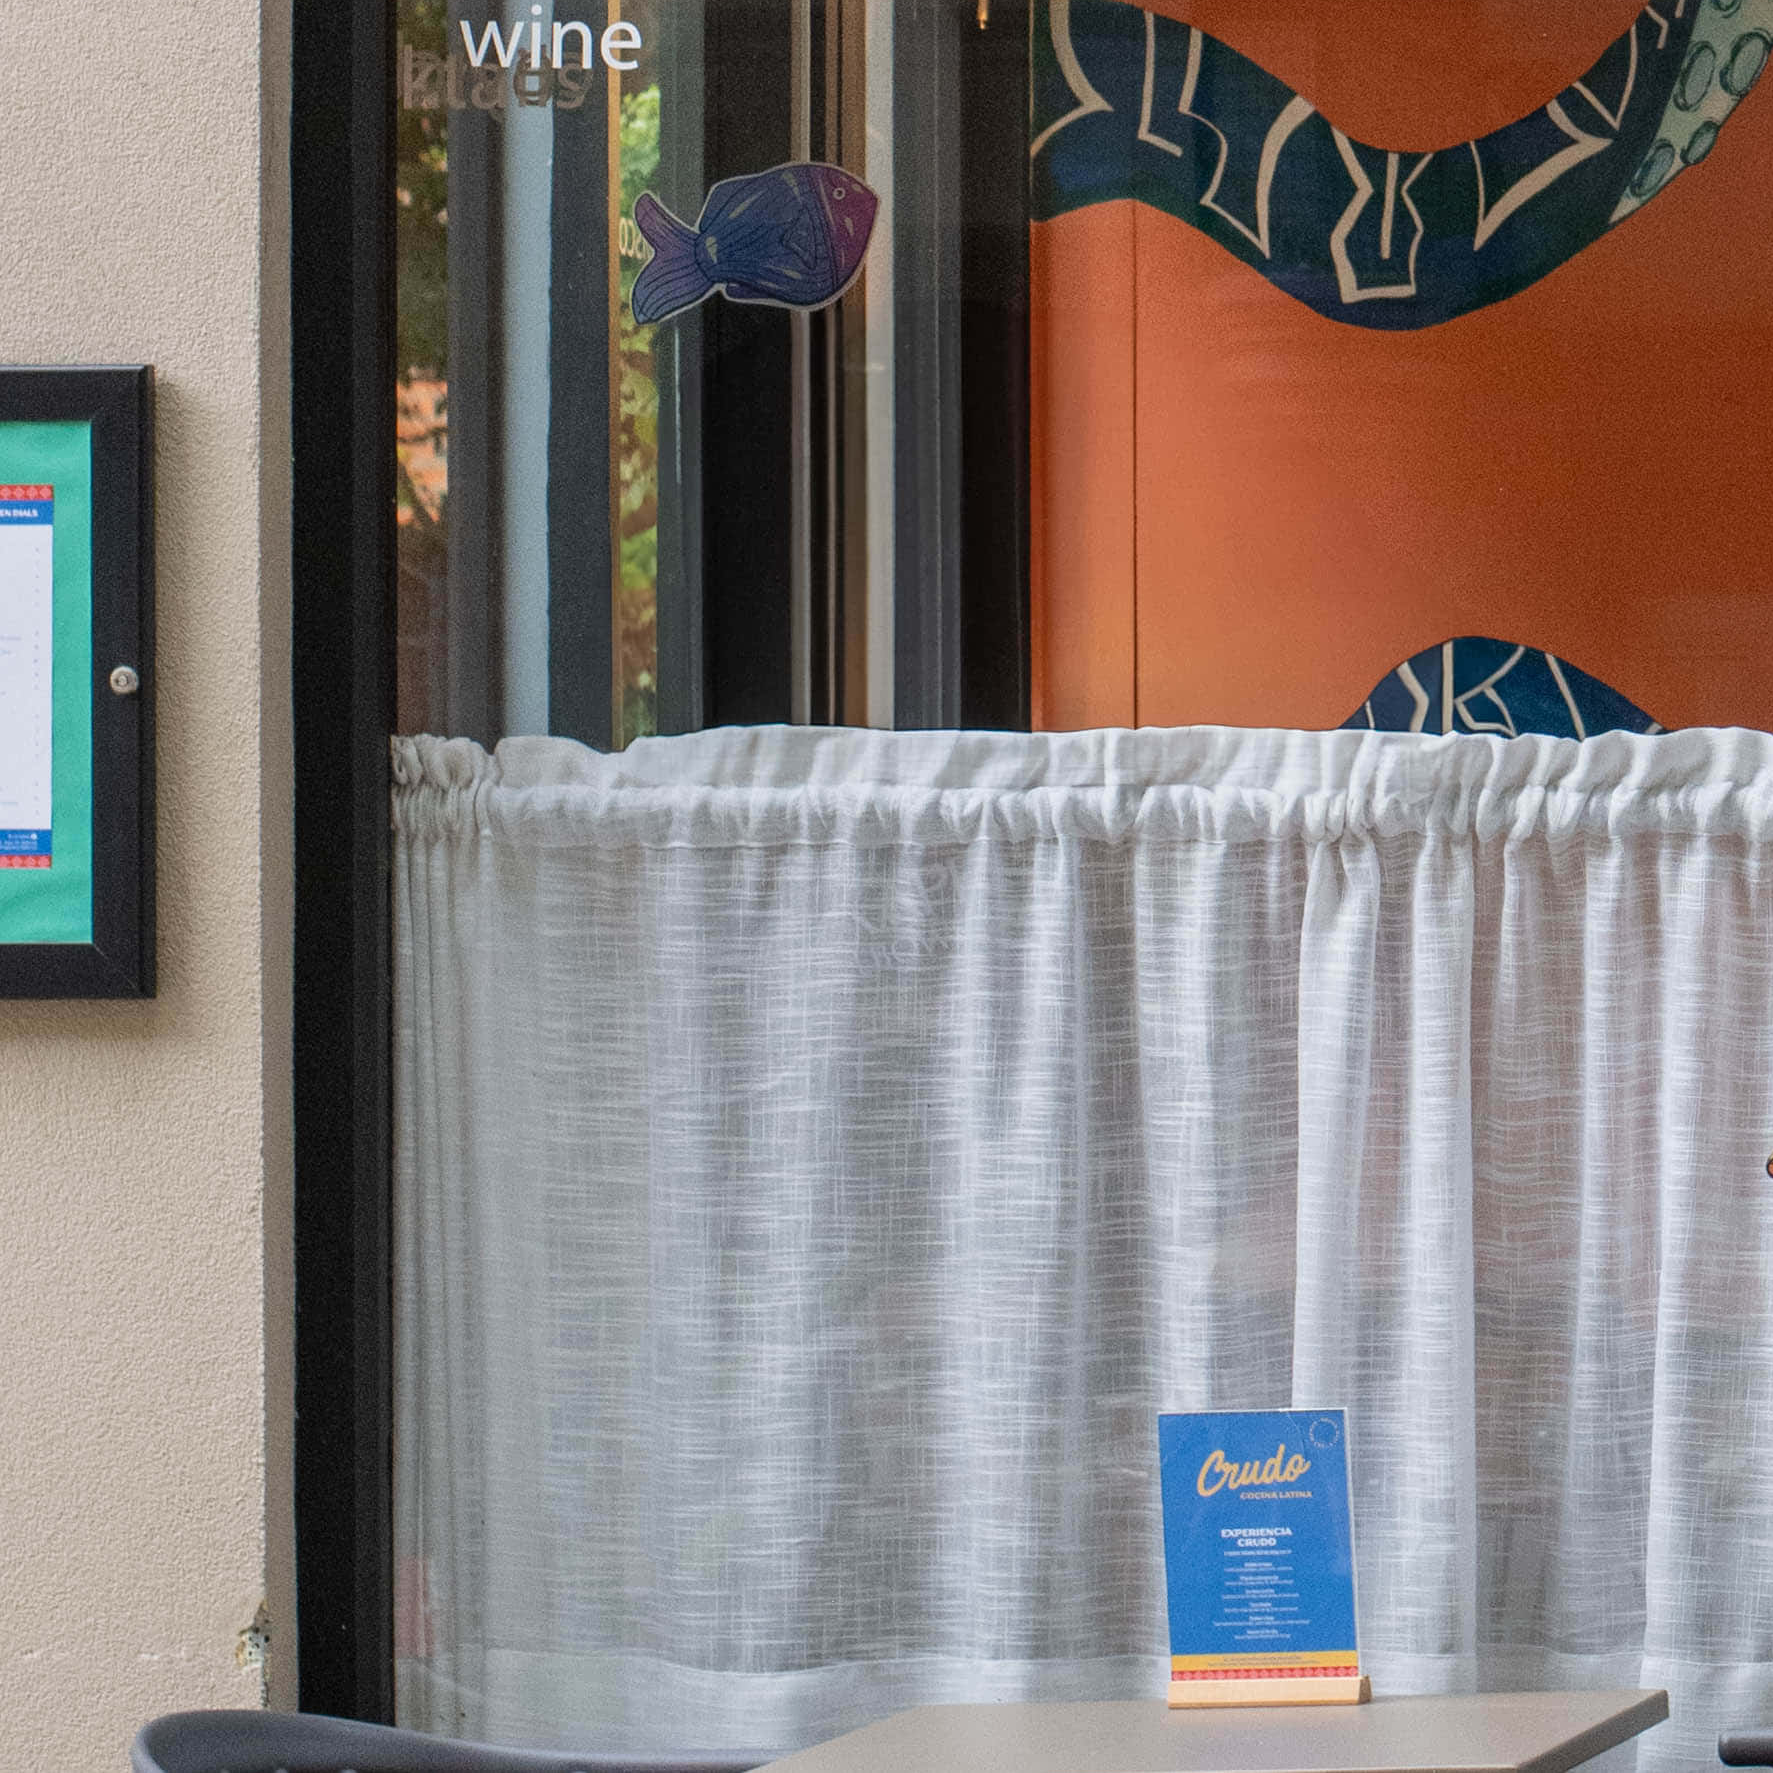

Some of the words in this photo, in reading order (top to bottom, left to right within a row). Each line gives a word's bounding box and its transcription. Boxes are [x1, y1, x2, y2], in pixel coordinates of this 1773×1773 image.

[459, 5, 642, 71] wine
[1196, 1443, 1312, 1498] Crudo
[1220, 1527, 1293, 1538] EXPERIENCIA
[1236, 1537, 1278, 1548] CRUDO
